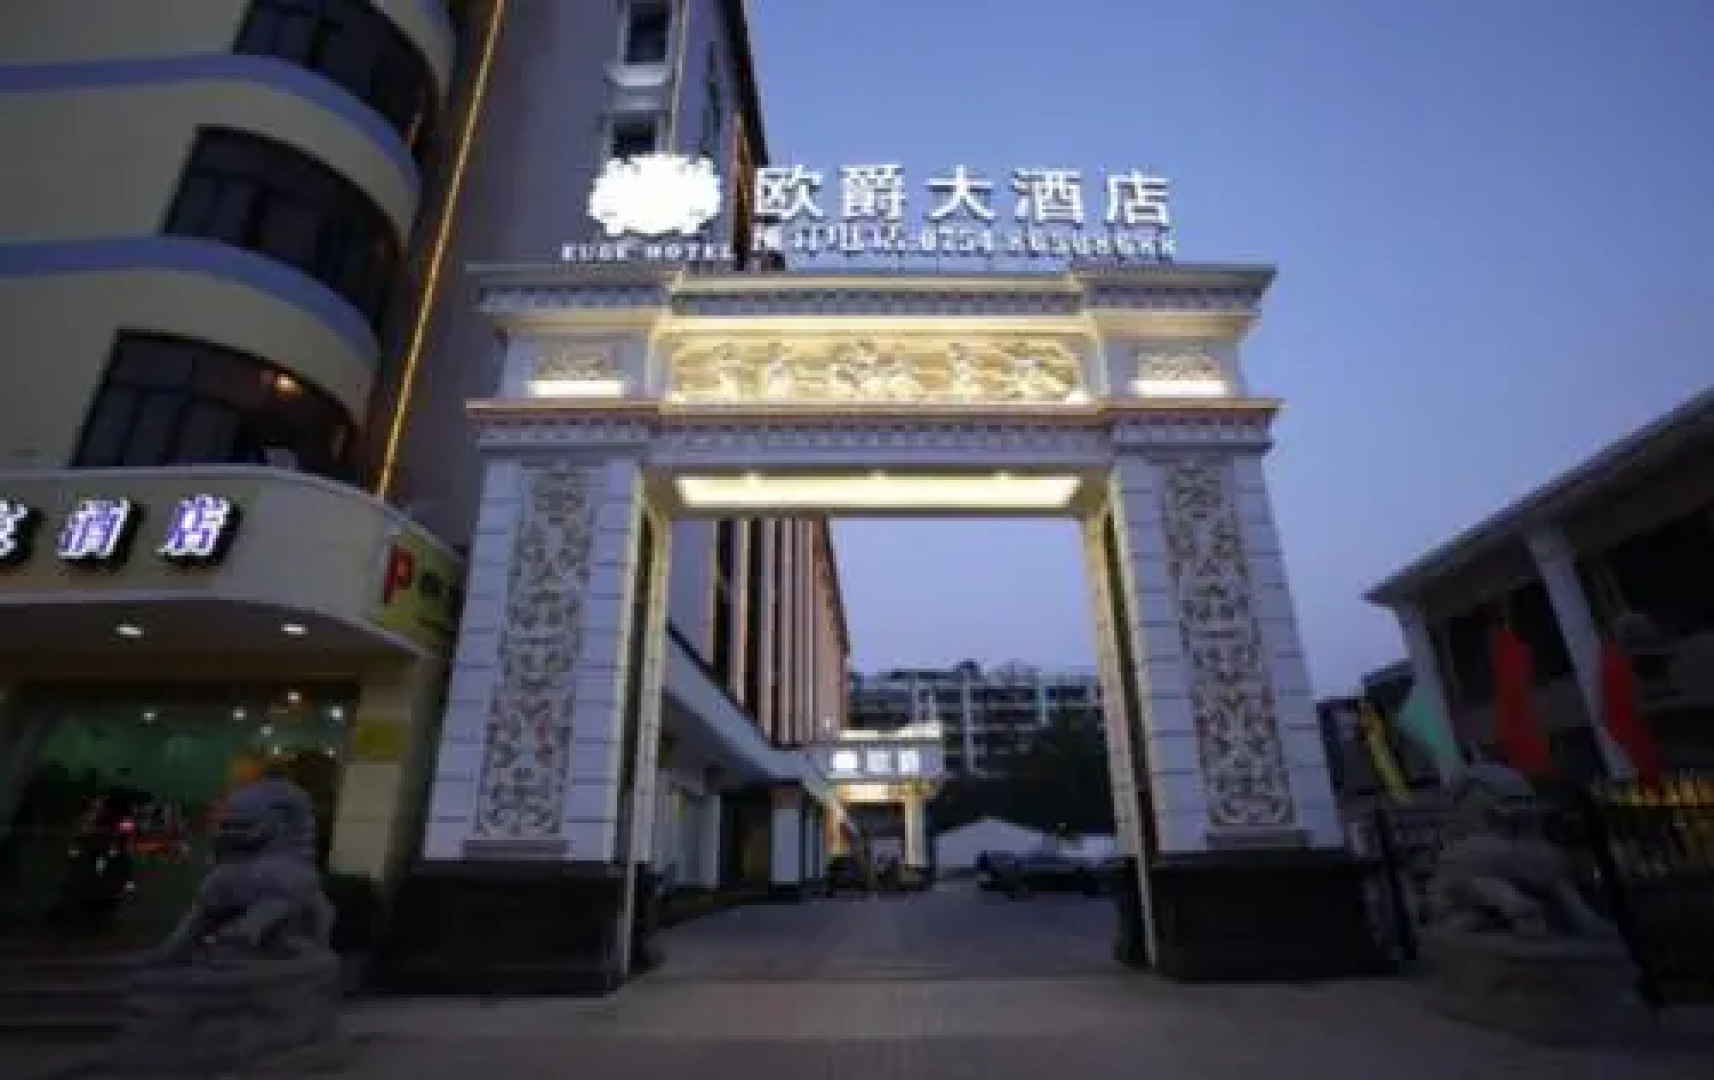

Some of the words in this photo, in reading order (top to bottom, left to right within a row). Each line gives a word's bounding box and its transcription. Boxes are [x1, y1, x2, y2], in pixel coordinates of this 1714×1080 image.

[753, 164, 1170, 224] 欧爵大酒店
[645, 242, 737, 261] HOTEL
